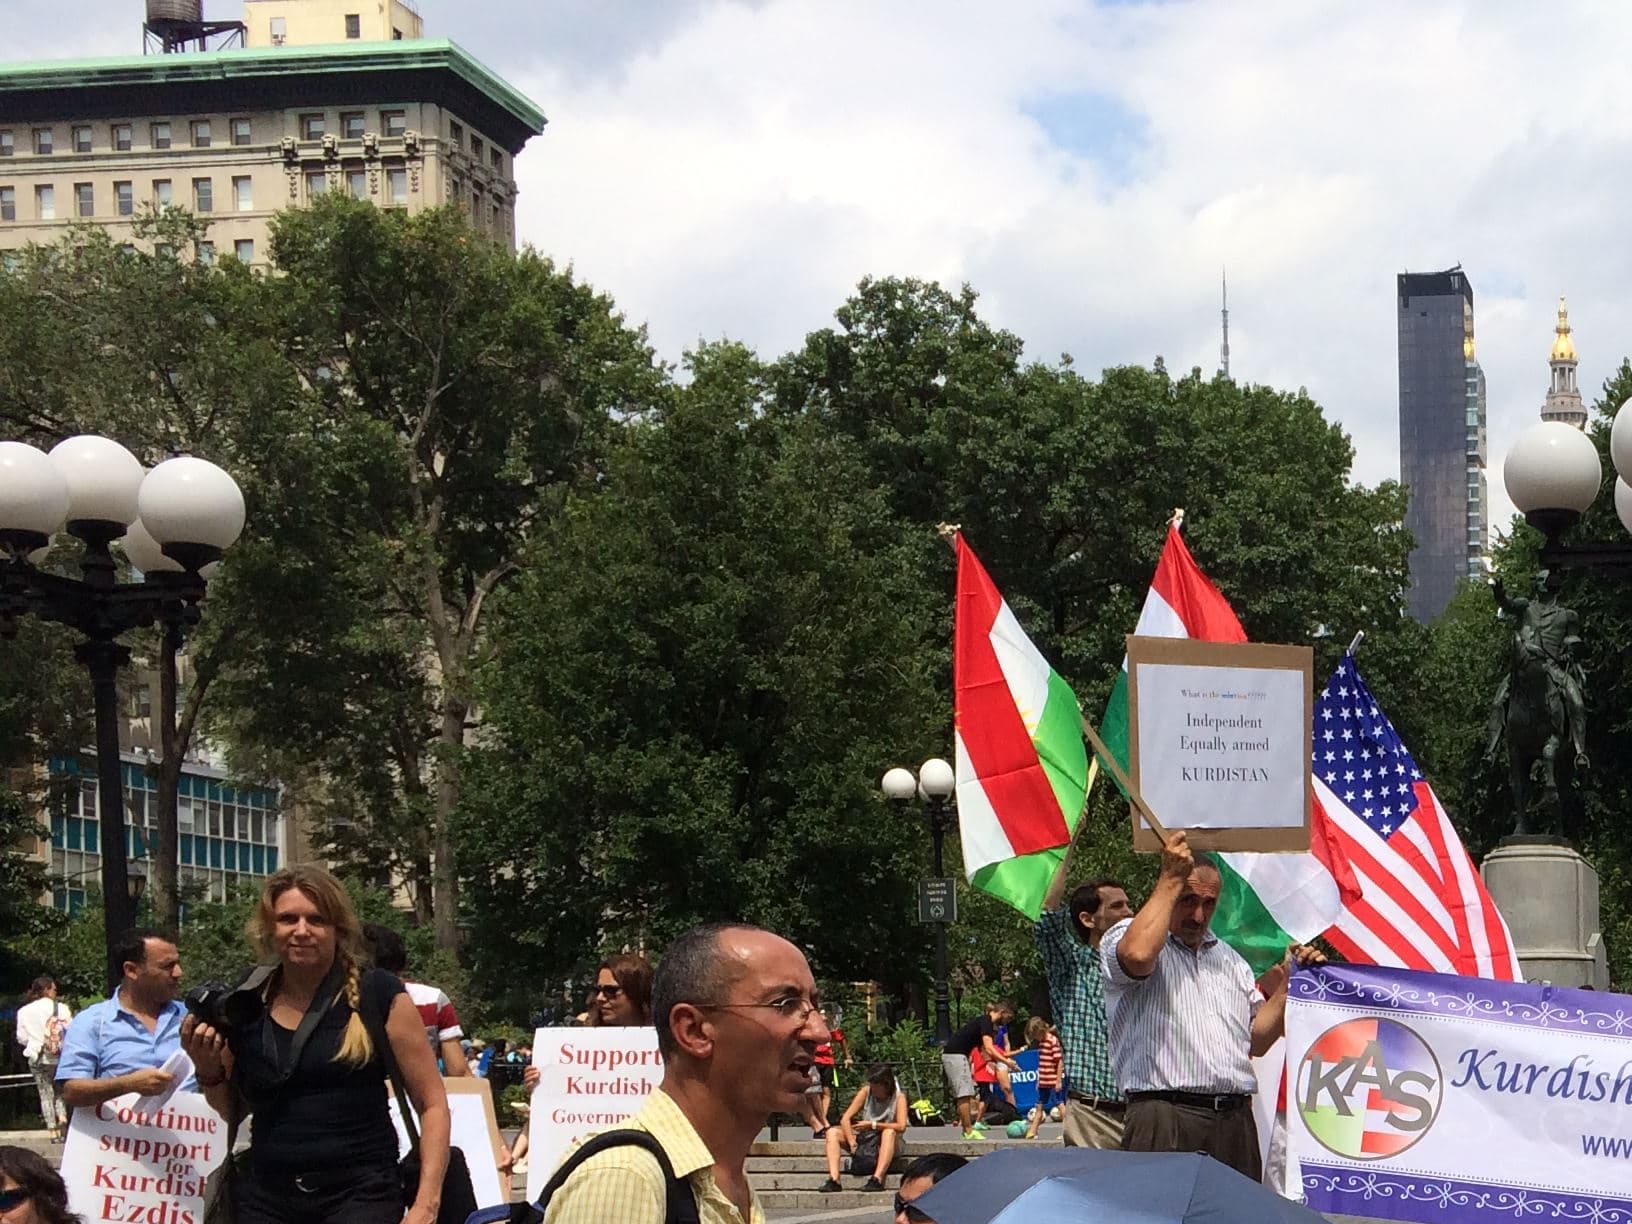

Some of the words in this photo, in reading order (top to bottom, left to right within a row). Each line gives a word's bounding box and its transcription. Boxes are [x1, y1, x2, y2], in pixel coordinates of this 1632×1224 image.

[1186, 712, 1263, 732] Independent
[1180, 735, 1226, 754] Equally
[1232, 737, 1269, 751] armed
[1182, 767, 1268, 782] KURDISTAN
[559, 1043, 661, 1071] Support
[566, 1076, 652, 1096] Kurdish
[1008, 1070, 1040, 1083] NIO
[1303, 1040, 1437, 1132] KAS
[95, 1099, 217, 1136] Continue
[100, 1133, 212, 1163] support
[164, 1158, 194, 1175] for
